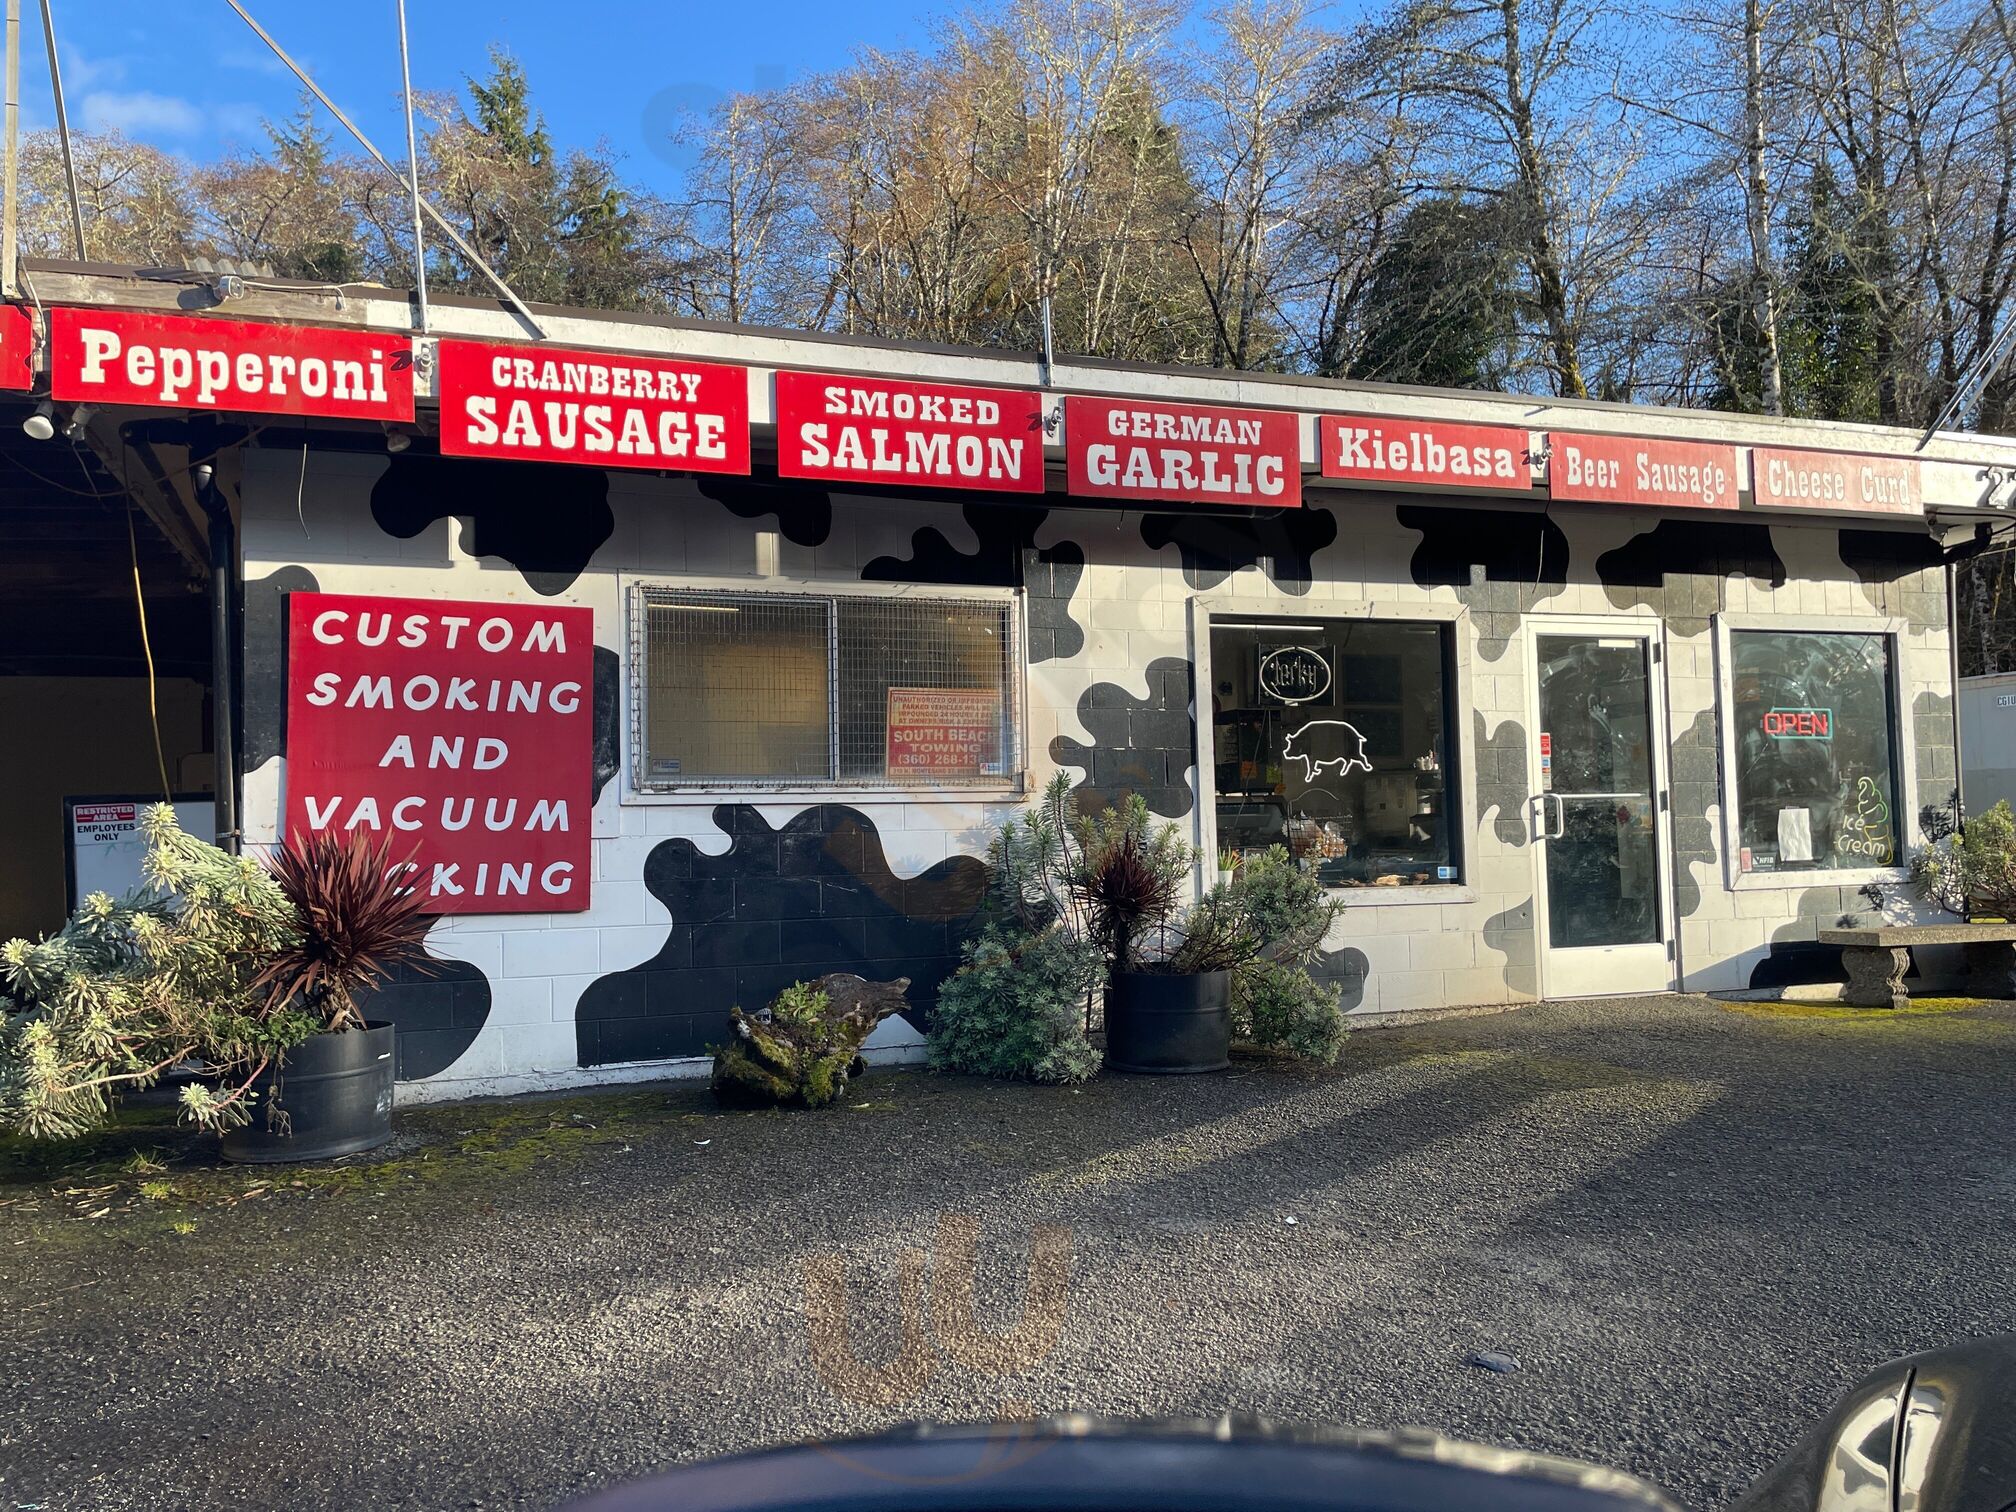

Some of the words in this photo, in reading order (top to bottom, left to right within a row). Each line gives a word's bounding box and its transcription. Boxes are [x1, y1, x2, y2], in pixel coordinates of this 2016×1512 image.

[80, 328, 389, 404] Pepperoni
[492, 356, 702, 403] CRANBERRY
[825, 386, 1000, 425] SMOKED
[466, 395, 727, 460] SAUSAGE
[1108, 409, 1262, 447] GERMAN
[801, 423, 1024, 480] SALMON
[1087, 444, 1284, 497] GARLIC
[1338, 426, 1516, 479] Kielbasa
[1566, 447, 1620, 490] Beer
[1636, 454, 1726, 503] Sausage
[1768, 459, 1845, 501] Cheese
[1860, 465, 1911, 506] Curd
[312, 610, 567, 653] CUSTOM
[306, 672, 582, 714] SMOKING
[894, 729, 944, 742] SOUTH
[1763, 712, 1828, 735] OPEN
[379, 735, 509, 770] AND
[898, 754, 930, 765] (360)
[910, 743, 982, 753] TOWING
[76, 806, 133, 815] RESTRICTED
[77, 823, 135, 833] EMPLOYEES
[93, 813, 119, 821] AREA
[304, 796, 569, 832] VACUUM
[94, 832, 119, 841] ONLY
